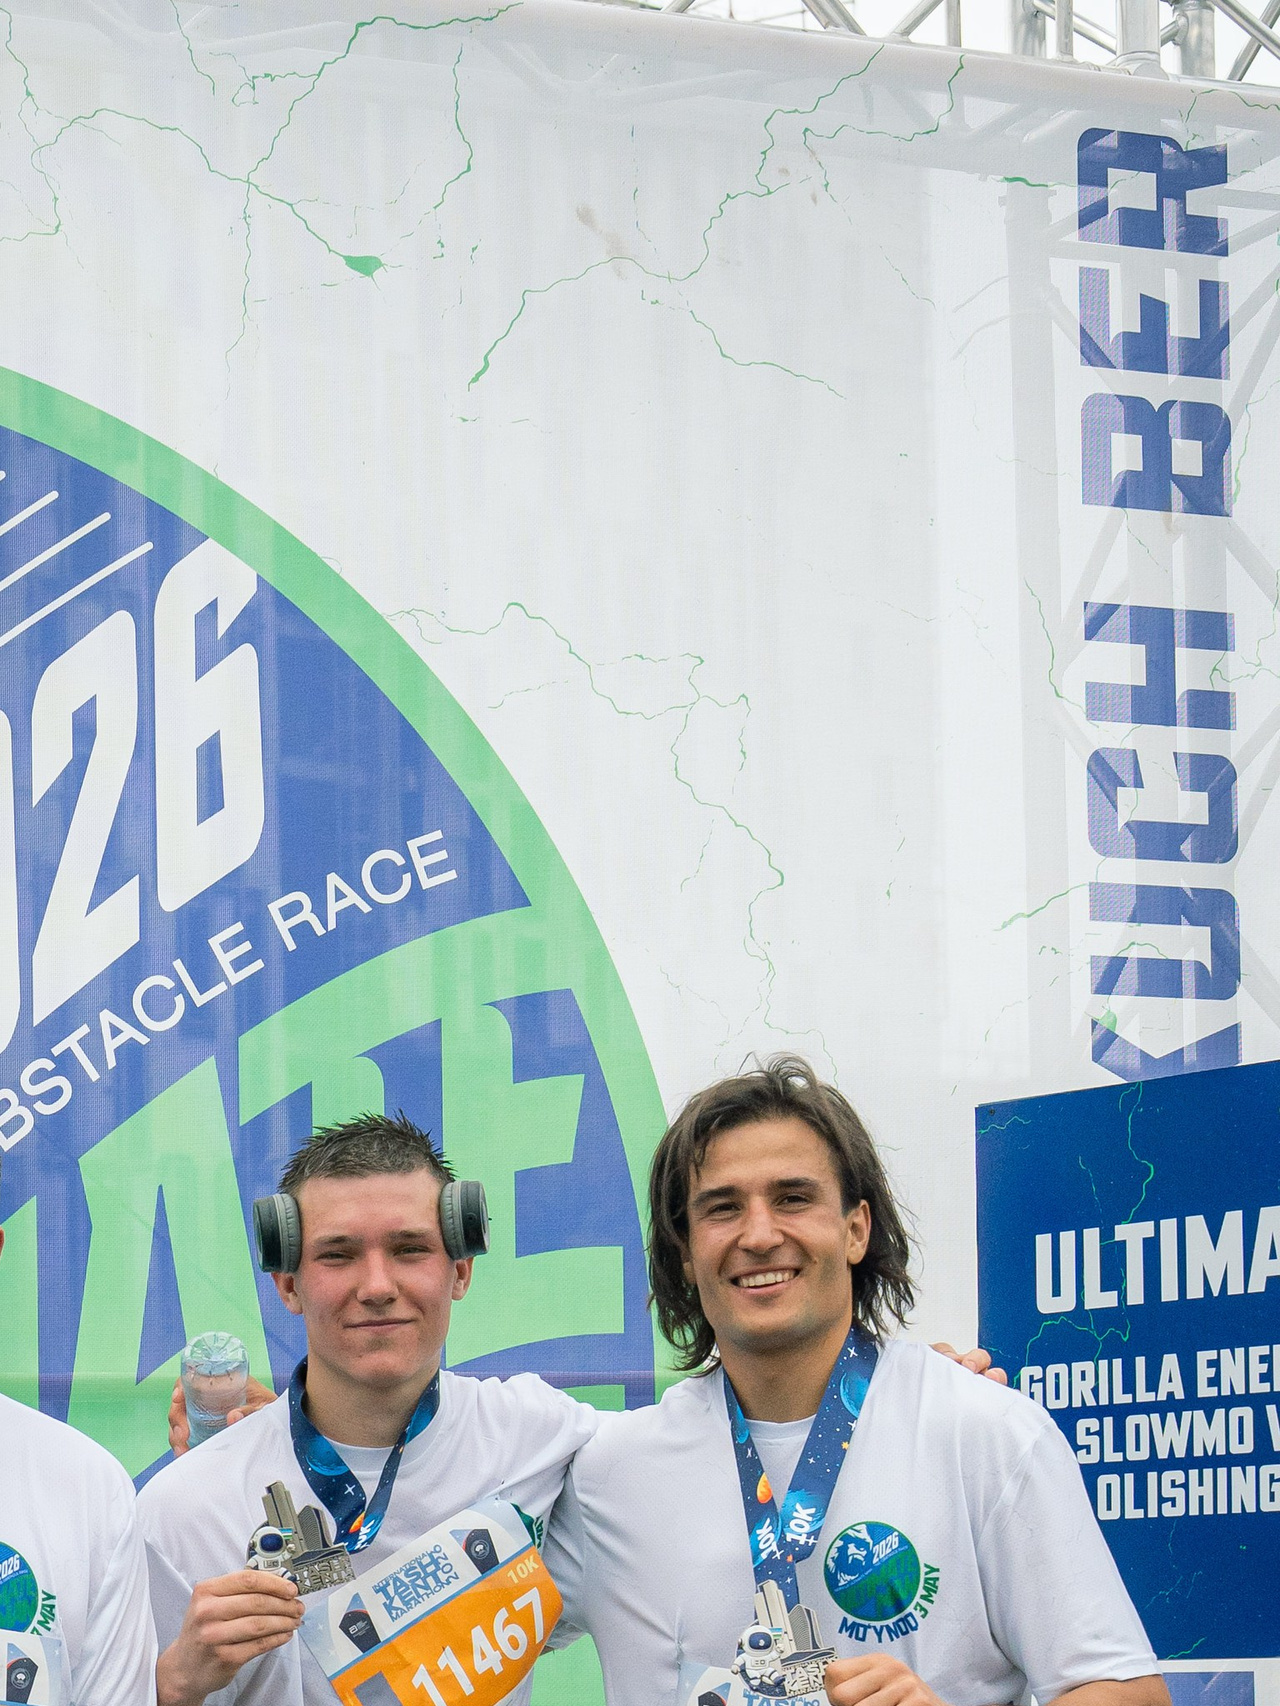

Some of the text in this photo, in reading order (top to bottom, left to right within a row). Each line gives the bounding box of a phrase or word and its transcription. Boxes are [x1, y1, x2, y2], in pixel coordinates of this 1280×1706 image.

[1076, 127, 1233, 517] BER
[269, 829, 460, 952] RACE
[1021, 1353, 1185, 1410] GORILLA
[1075, 1406, 1255, 1464] SLOWMO
[755, 1517, 776, 1559] 10K
[786, 1502, 817, 1545] 10K
[506, 1554, 540, 1585] 10K
[872, 1530, 900, 1565] 2026
[373, 1552, 441, 1602] TASH
[382, 1570, 441, 1616] KENT
[920, 1562, 941, 1605] MAY
[36, 1588, 57, 1632] MAY
[913, 1601, 929, 1619] 3
